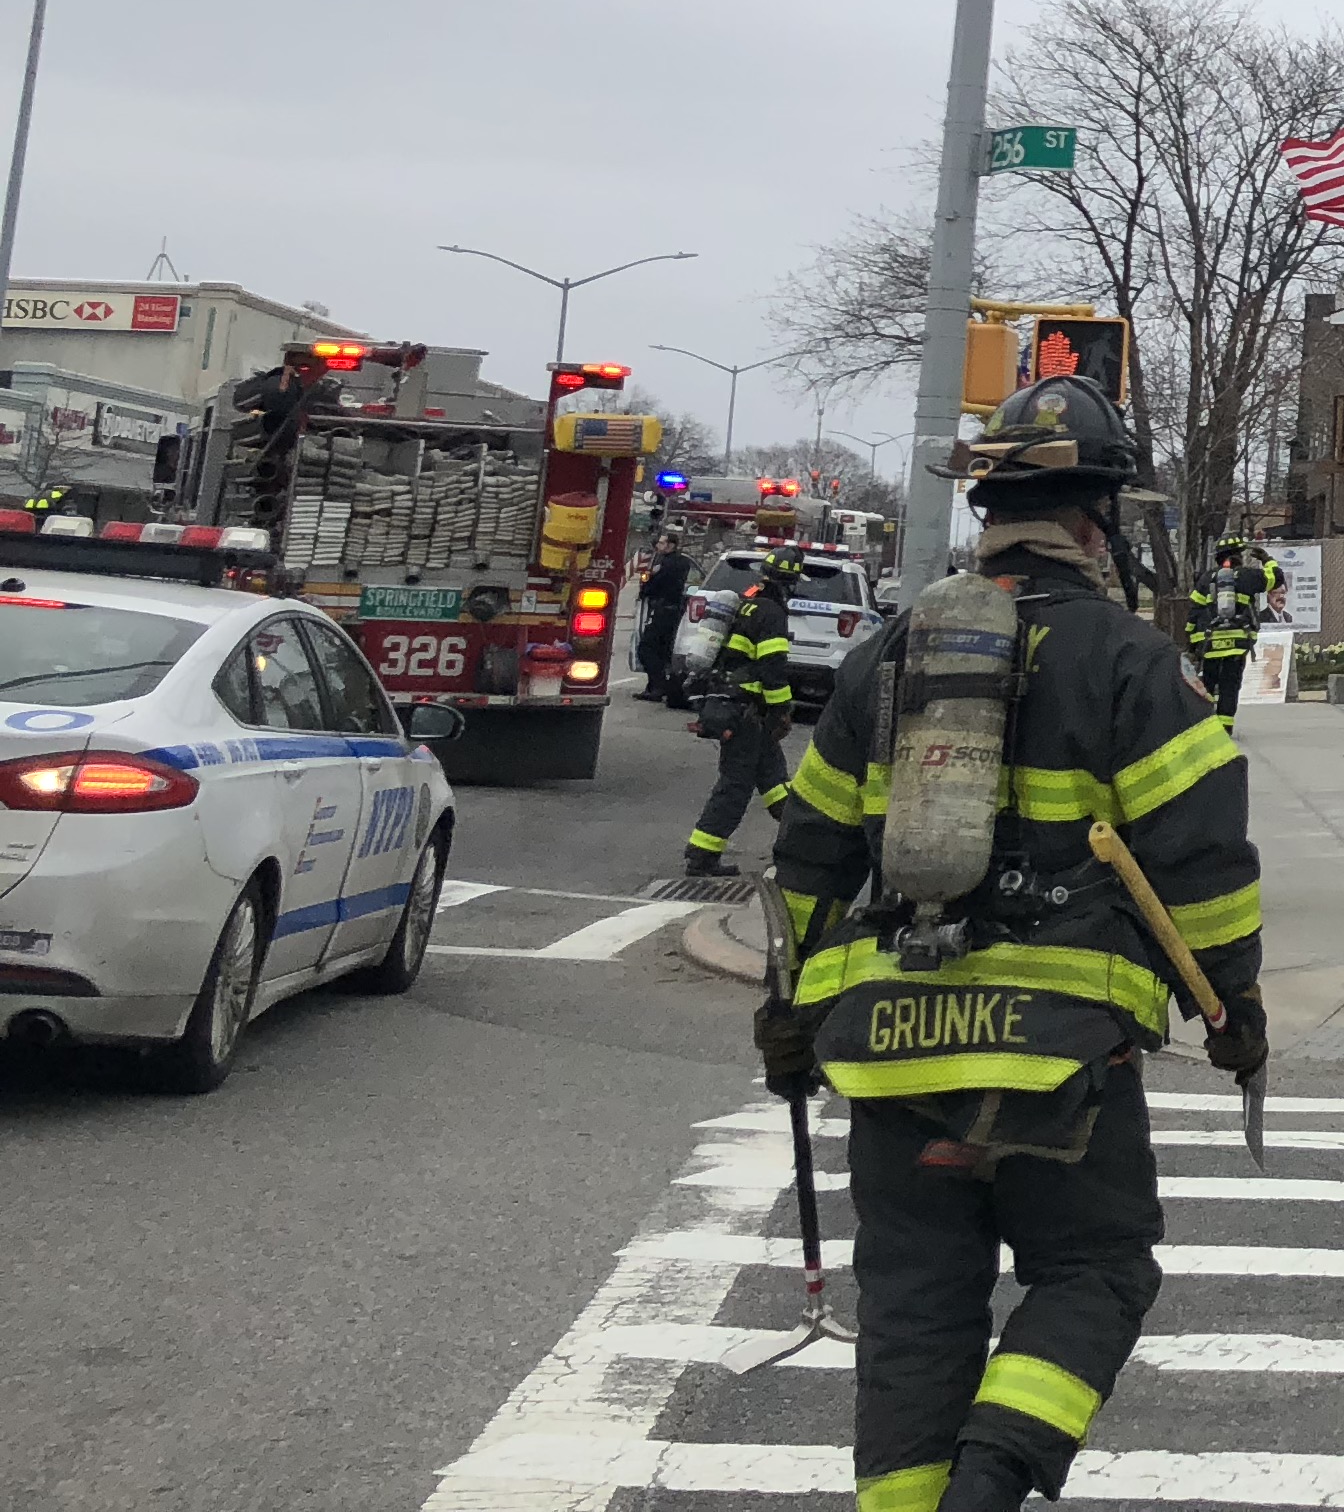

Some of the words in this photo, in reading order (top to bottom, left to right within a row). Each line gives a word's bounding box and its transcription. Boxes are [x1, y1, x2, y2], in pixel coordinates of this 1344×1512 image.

[991, 131, 1025, 168] 256
[1044, 130, 1069, 149] ST
[366, 588, 457, 609] SPRINGFIELD
[376, 606, 442, 618] BOULEVARD
[791, 600, 832, 612] POLICE
[379, 635, 467, 677] 326
[869, 992, 1033, 1053] GRUNKE
